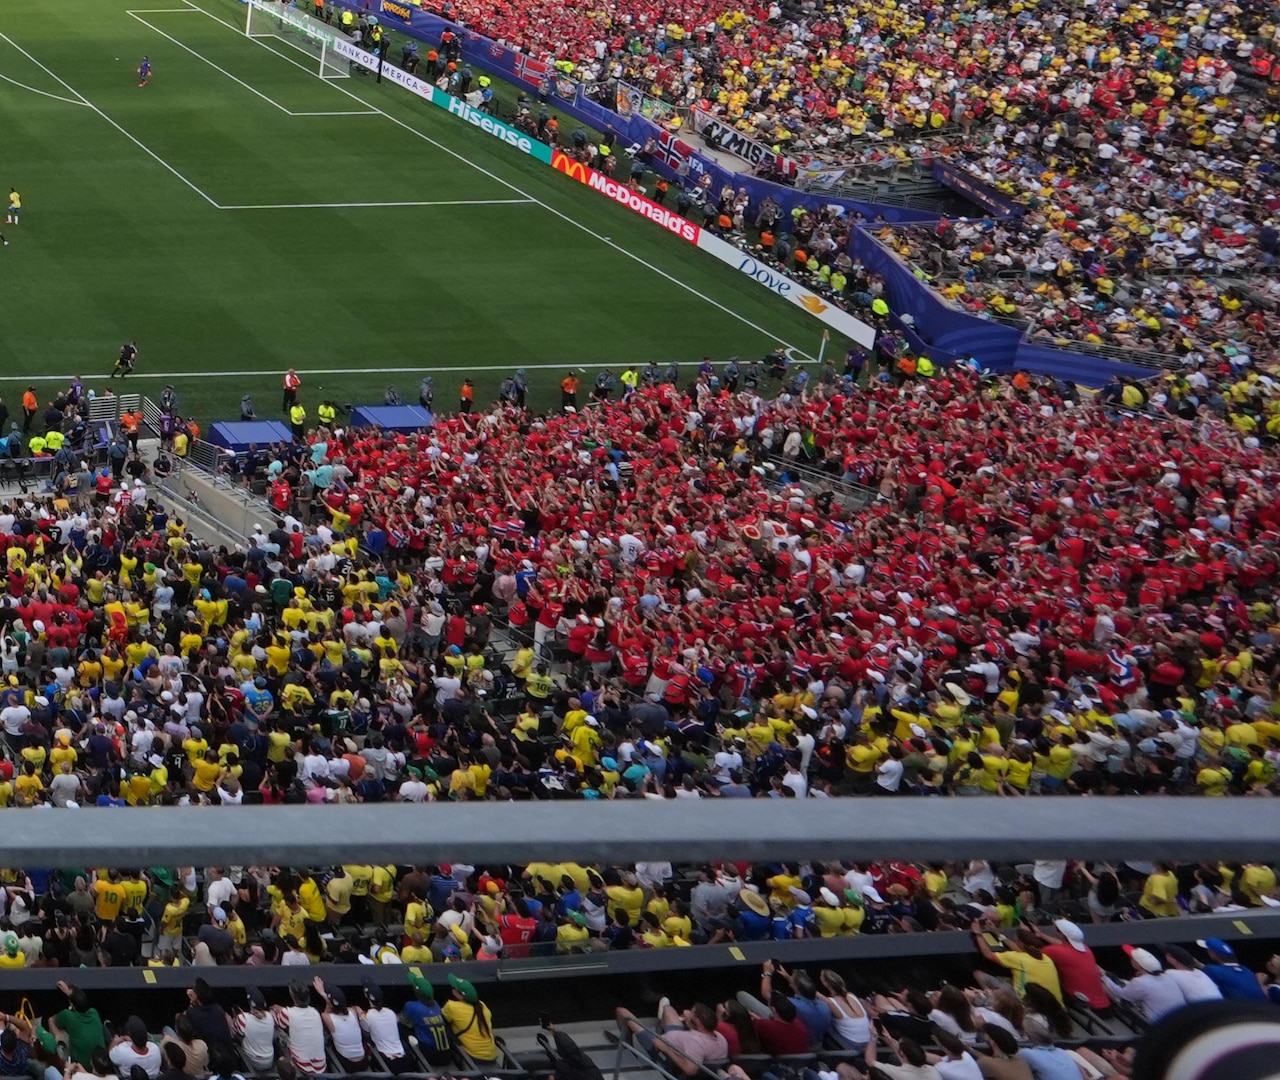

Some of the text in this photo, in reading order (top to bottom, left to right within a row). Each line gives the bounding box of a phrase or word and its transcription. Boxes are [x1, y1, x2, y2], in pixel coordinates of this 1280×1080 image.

[336, 38, 362, 60] BANK
[362, 55, 375, 69] OF
[447, 96, 533, 154] Hisense
[588, 172, 696, 241] McDonald's
[738, 253, 791, 298] Dove
[105, 891, 118, 904] 10
